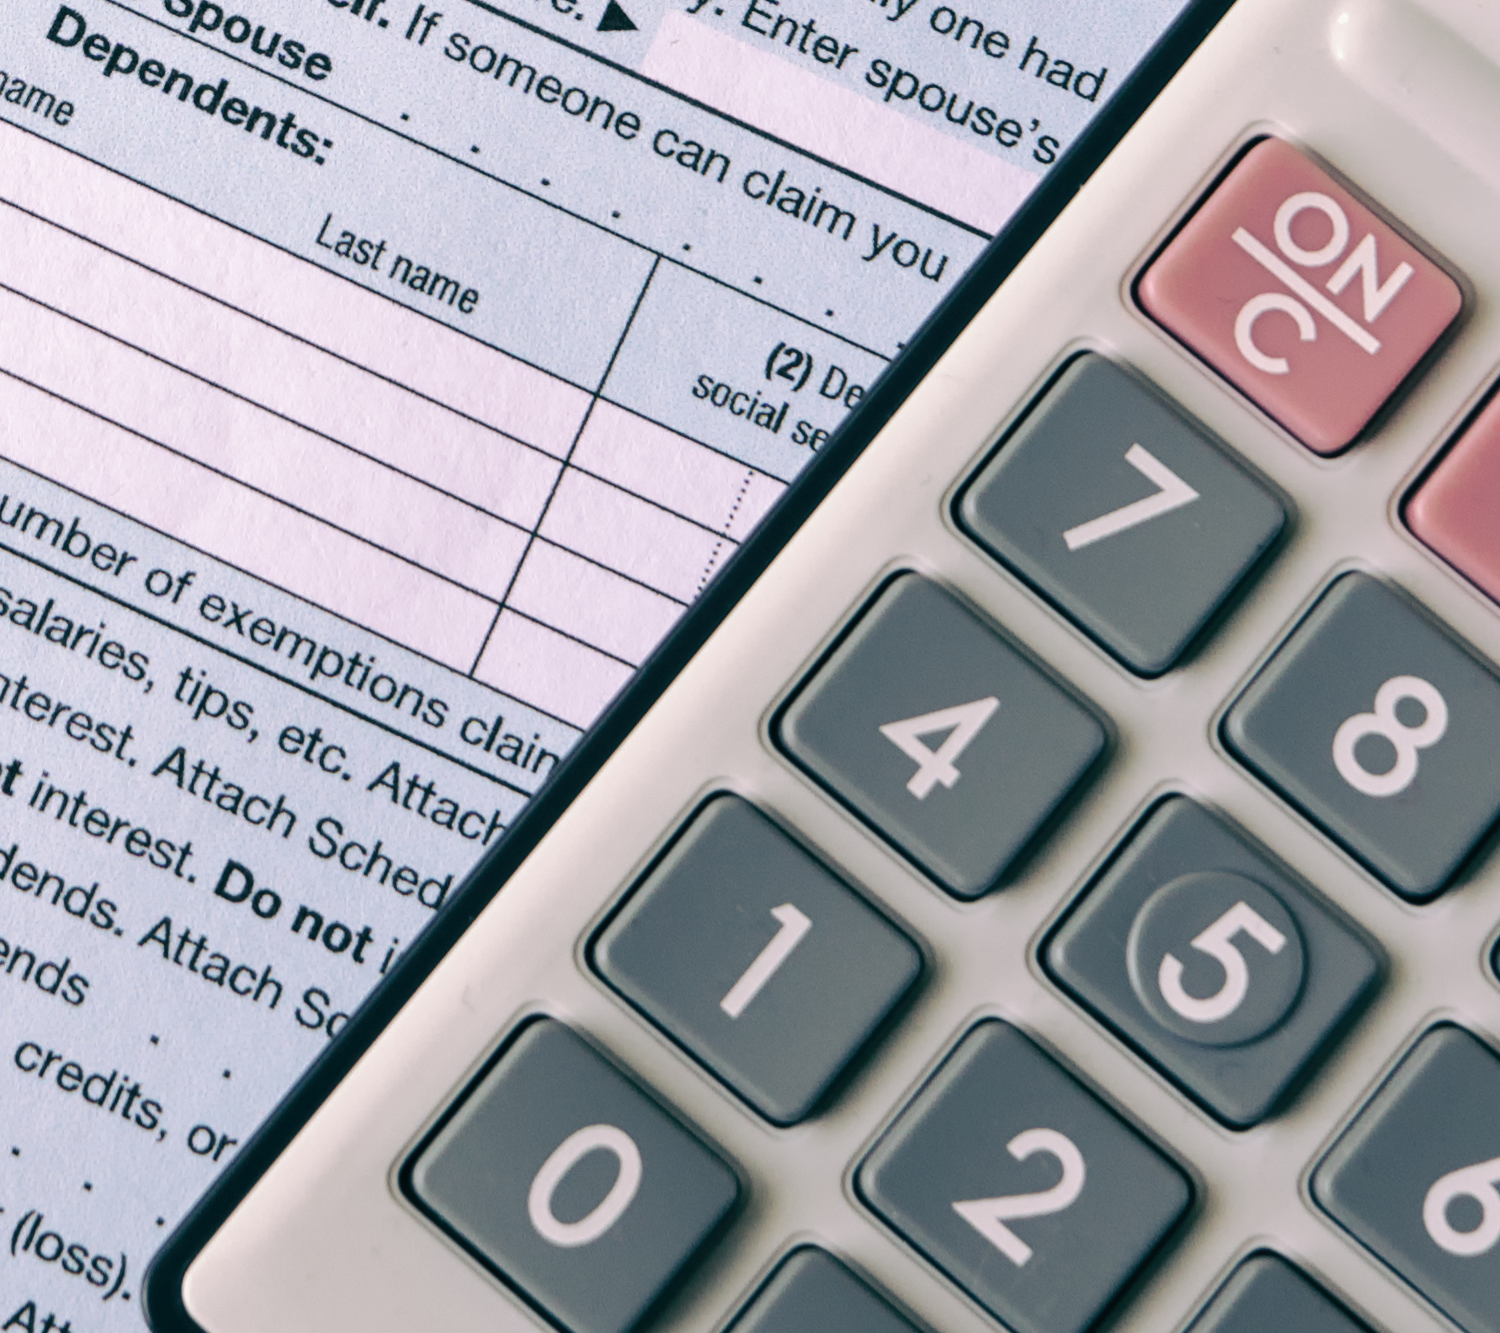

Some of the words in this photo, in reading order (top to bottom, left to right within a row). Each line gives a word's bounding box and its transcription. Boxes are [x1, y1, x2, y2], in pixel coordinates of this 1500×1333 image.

[45, 3, 334, 167] Dependents:
[929, 5, 1011, 60] one
[1017, 35, 1109, 104] had
[404, 3, 444, 47] If
[443, 32, 642, 141] someone
[652, 128, 732, 185] can
[741, 168, 858, 242] claim
[861, 223, 950, 283] you
[314, 212, 388, 272] Last
[388, 253, 480, 315] name
[1273, 191, 1412, 322] ON
[1234, 292, 1317, 374] C
[1062, 443, 1199, 551] 7
[878, 696, 1000, 799] 4
[1333, 675, 1448, 796] 8
[720, 903, 813, 1018] 1
[1158, 901, 1287, 1023] 5
[13, 1041, 168, 1143] credits,
[186, 1124, 238, 1163] or
[527, 1124, 642, 1247] 0
[951, 1128, 1086, 1266] 2
[9, 1208, 131, 1301] (loss).
